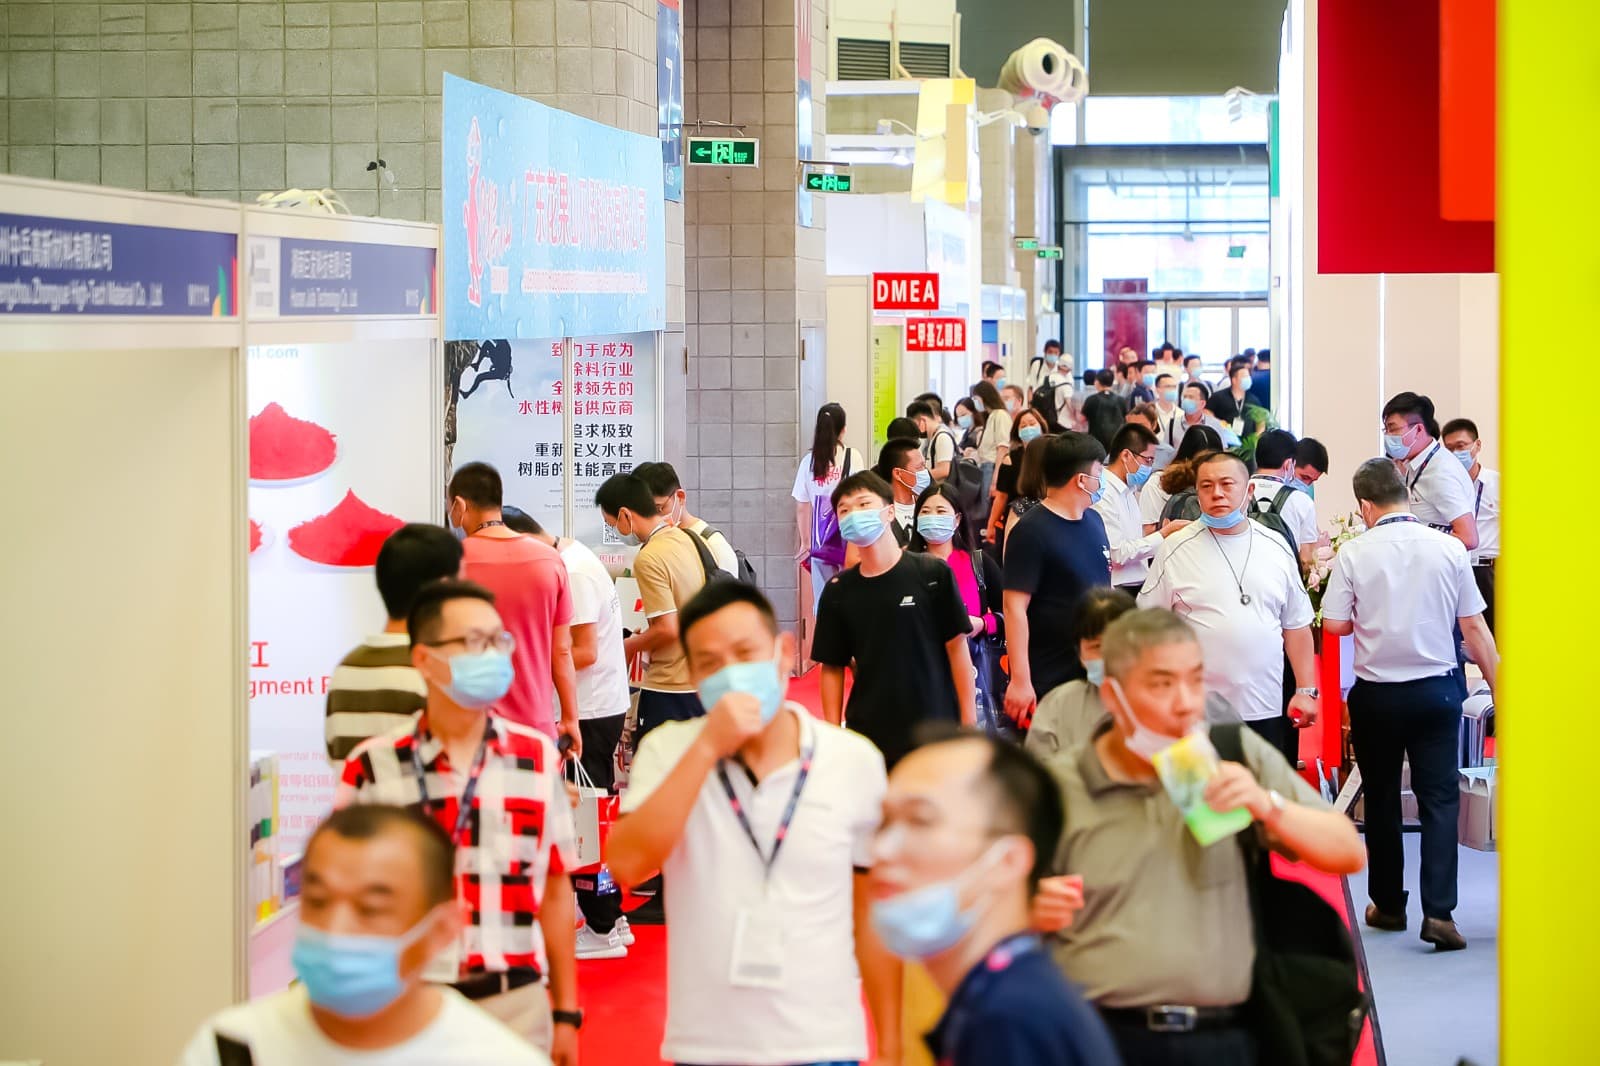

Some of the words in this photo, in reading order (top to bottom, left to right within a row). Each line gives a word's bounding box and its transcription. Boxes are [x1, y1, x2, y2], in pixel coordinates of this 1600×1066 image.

[877, 279, 935, 302] DMEA
[552, 343, 633, 357] 致力于成为
[552, 381, 633, 396] 全球领先的
[518, 400, 633, 415] 水性树脂供应商
[535, 442, 633, 458] 重新定义水性
[518, 461, 633, 477] 树脂的性能高度
